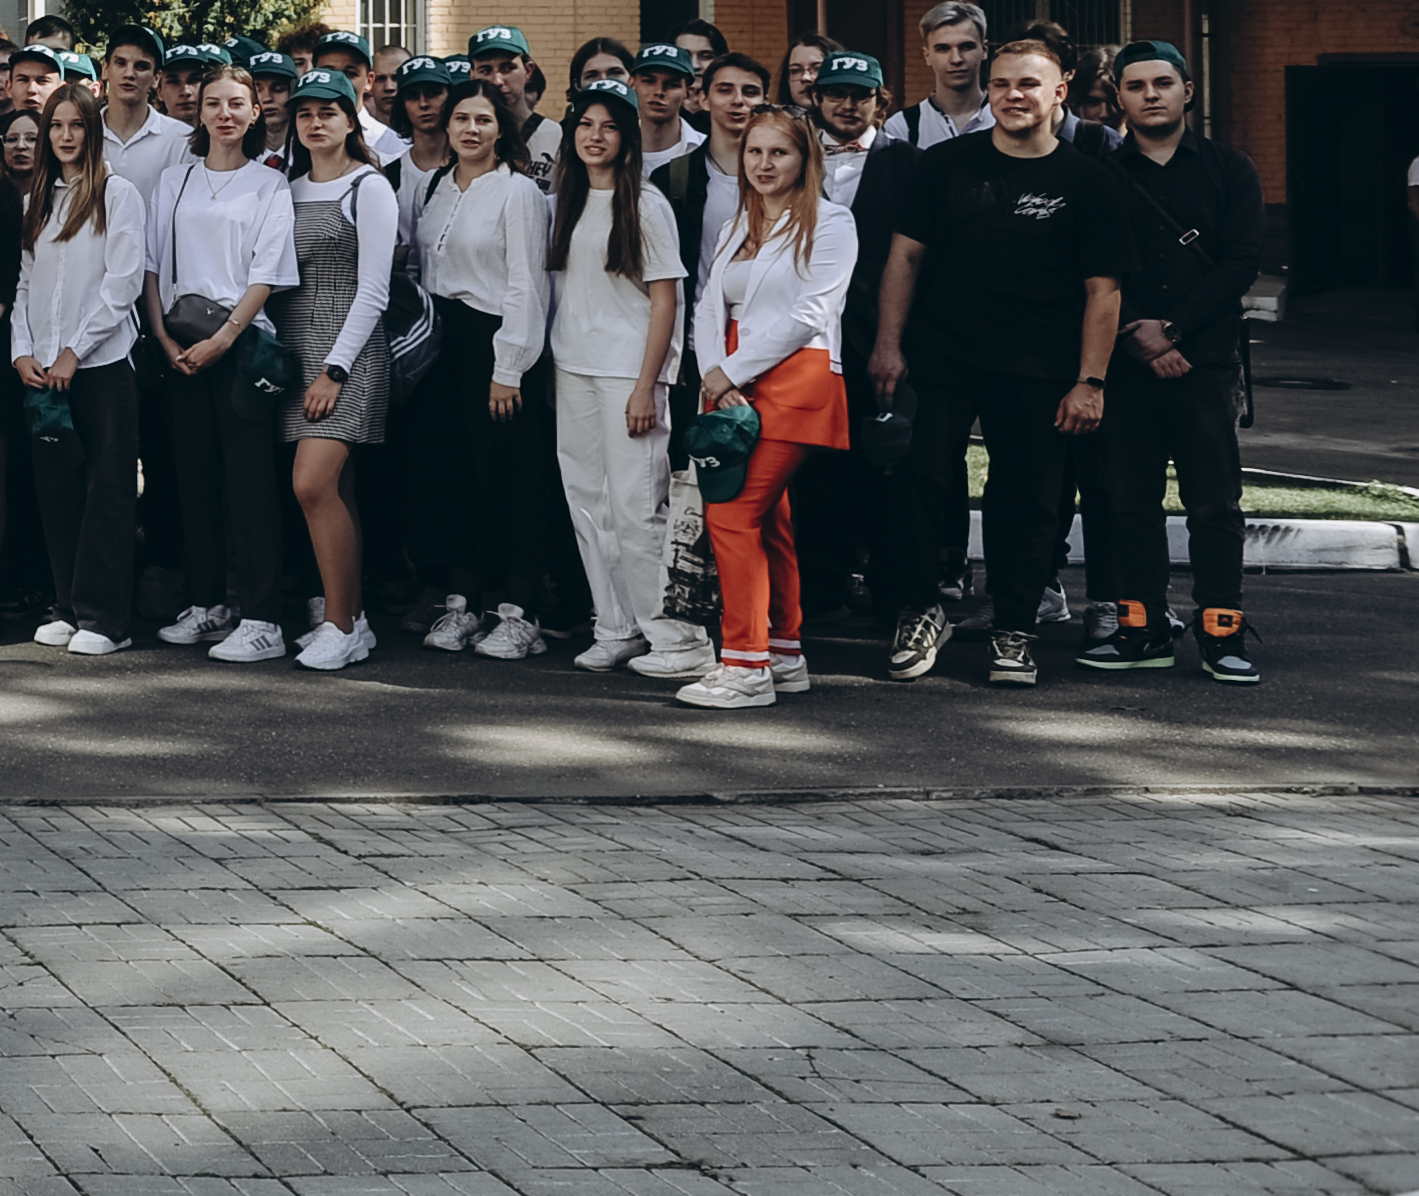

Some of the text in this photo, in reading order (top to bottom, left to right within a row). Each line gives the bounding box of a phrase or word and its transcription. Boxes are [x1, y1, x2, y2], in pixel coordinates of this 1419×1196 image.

[477, 27, 512, 43] ГУЗ
[165, 44, 198, 59] ГУЗ
[642, 45, 678, 58] ГУЗ
[250, 52, 283, 68] ГУЗ
[403, 57, 436, 75] ГУЗ
[831, 56, 868, 72] ГУЗ
[297, 71, 331, 88] ГУЗ
[588, 78, 629, 96] ГУЗ
